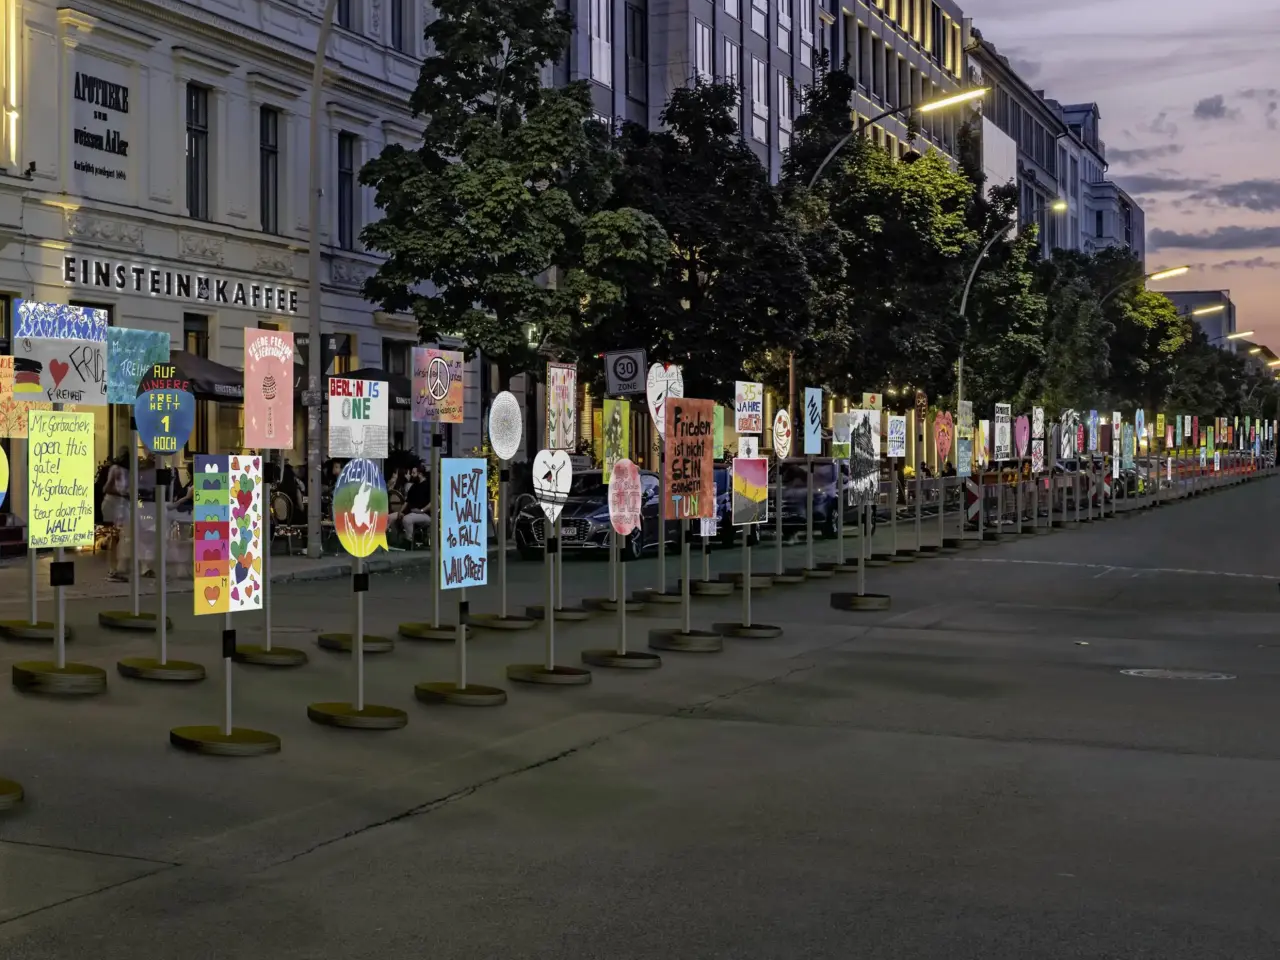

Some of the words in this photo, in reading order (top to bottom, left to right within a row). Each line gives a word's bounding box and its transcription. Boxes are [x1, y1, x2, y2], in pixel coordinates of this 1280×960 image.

[74, 72, 128, 113] APOTHEKE
[105, 129, 128, 157] Adler
[64, 257, 190, 298] EINSTEIN
[214, 280, 298, 313] KAFFEE
[154, 364, 176, 378] AUF
[618, 362, 633, 375] 30
[142, 379, 190, 391] UNSERE
[368, 381, 380, 398] IS
[617, 383, 637, 391] ZONE
[742, 383, 757, 401] 35
[149, 393, 178, 403] FREI
[149, 403, 181, 411] HEIT
[737, 401, 761, 413] JAHRE
[342, 397, 371, 420] ONE
[161, 415, 170, 432] 1
[674, 406, 711, 438] Frieden
[34, 441, 62, 462] open
[65, 437, 87, 456] this
[153, 436, 177, 451] HOCH
[674, 443, 684, 456] ist
[686, 441, 705, 458] nicht
[337, 458, 381, 490] FREEDOM
[671, 457, 702, 481] SEIN
[450, 468, 483, 511] NEXT
[671, 480, 701, 494] sondern
[33, 504, 53, 520] tear
[56, 501, 76, 518] down
[455, 498, 482, 525] WALL
[671, 494, 699, 519] TUN
[446, 527, 458, 548] to
[459, 524, 481, 547] FALL
[443, 556, 464, 586] WALL
[464, 554, 487, 581] STREET
